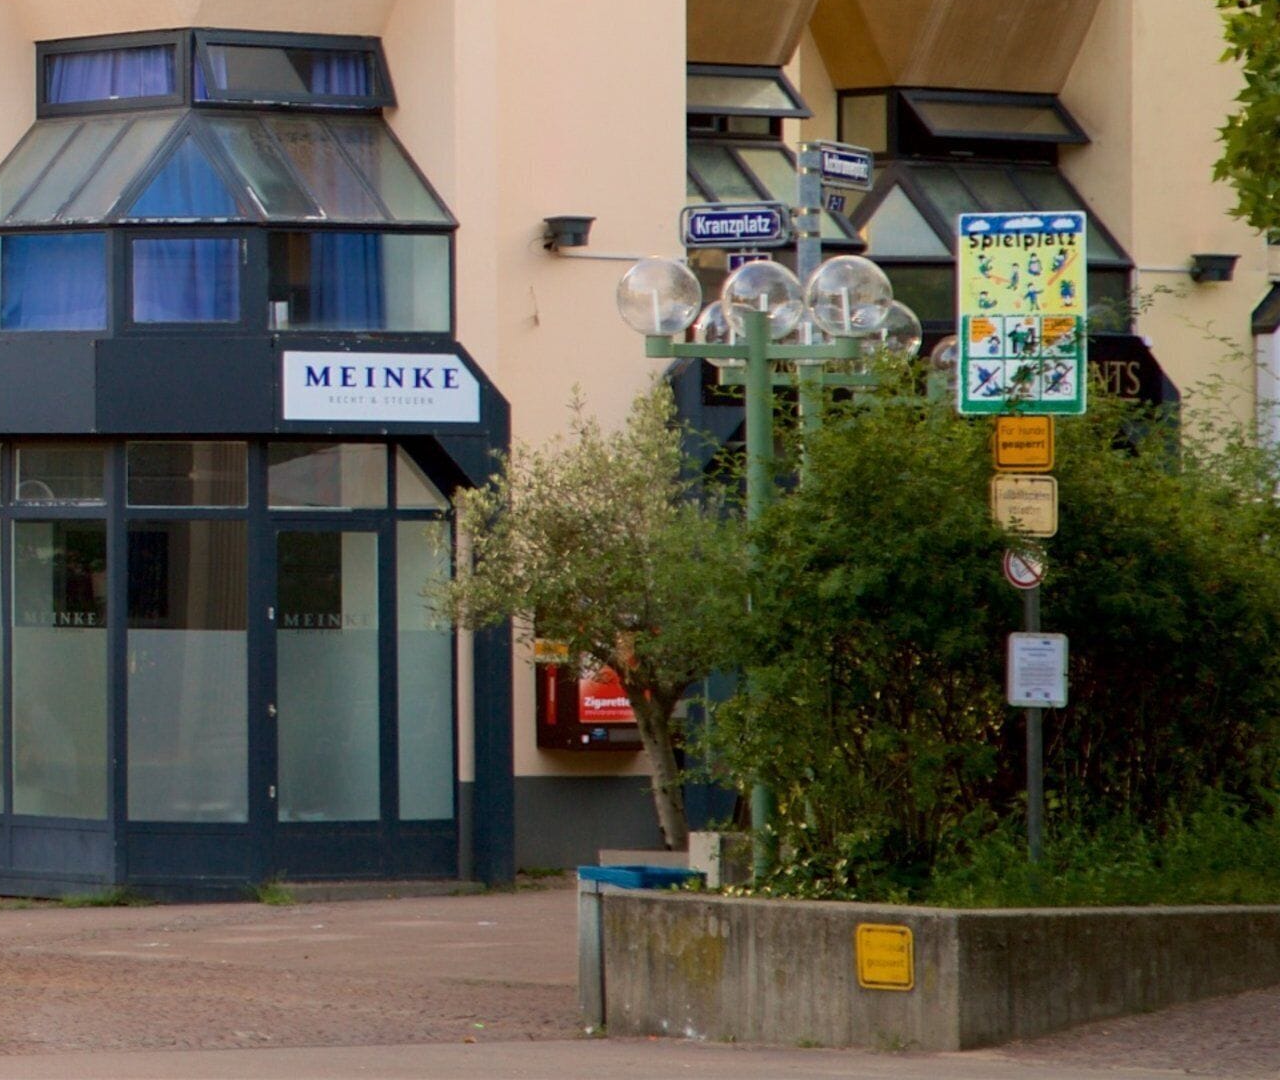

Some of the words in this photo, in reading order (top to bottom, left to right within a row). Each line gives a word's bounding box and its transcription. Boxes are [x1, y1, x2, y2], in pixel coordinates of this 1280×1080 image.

[696, 214, 771, 239] Kranzplatz
[968, 229, 1076, 251] Spielplatz
[305, 366, 460, 389] MEINKE
[329, 395, 364, 405] RECHT
